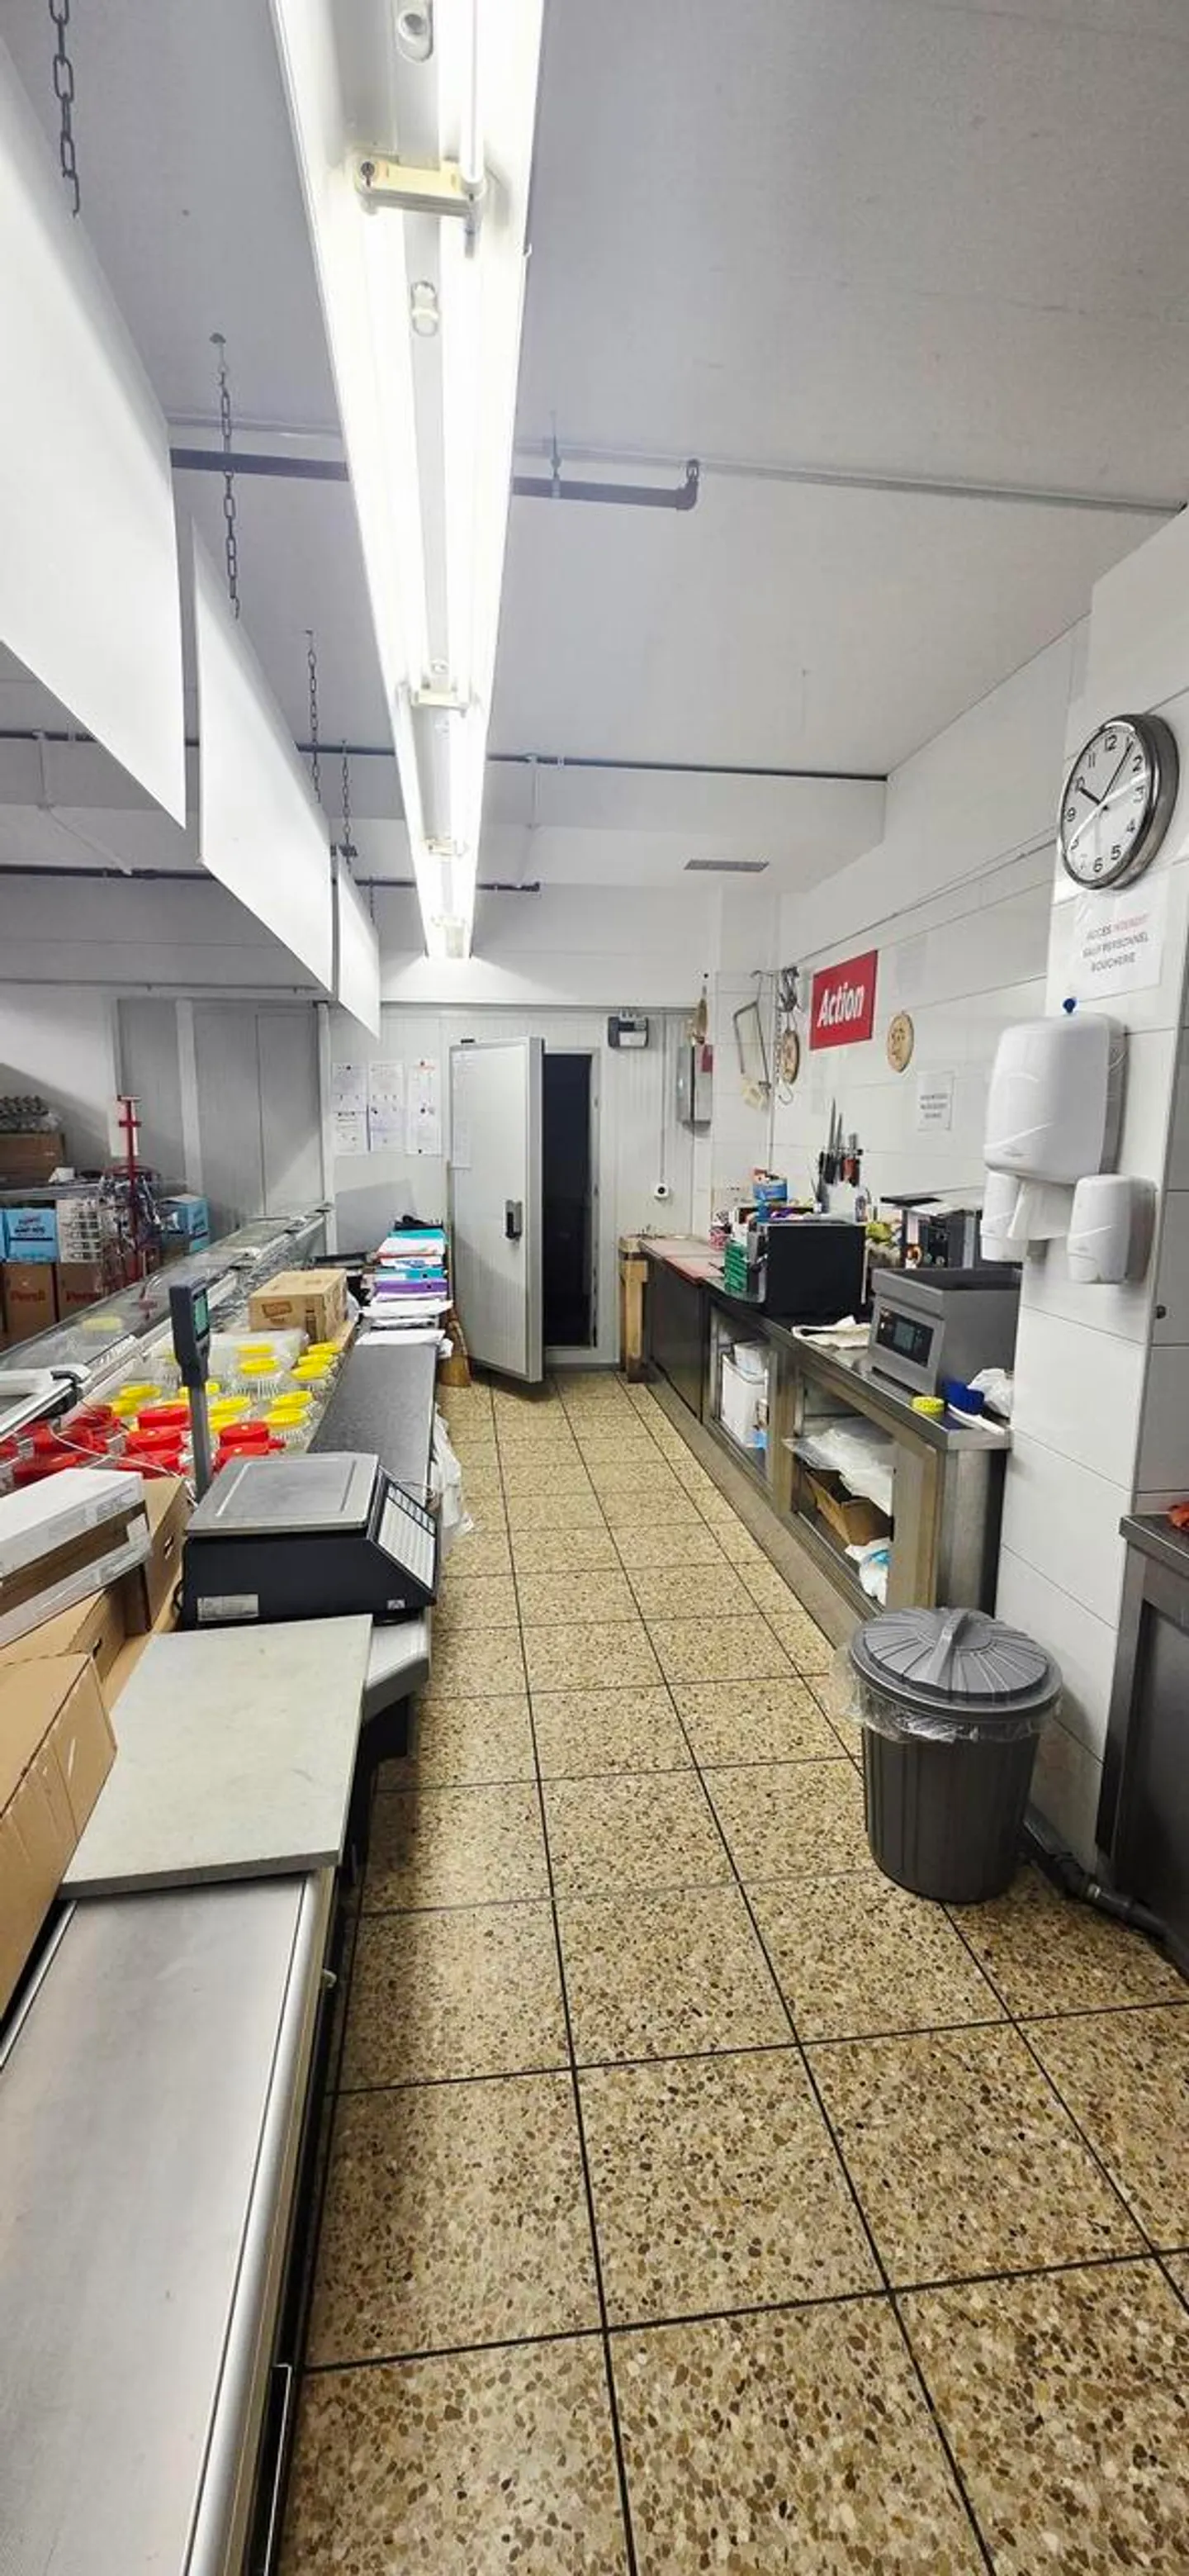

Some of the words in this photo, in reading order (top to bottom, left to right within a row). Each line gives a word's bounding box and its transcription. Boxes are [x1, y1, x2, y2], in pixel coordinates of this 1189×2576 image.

[1104, 734, 1117, 752] 12
[1087, 752, 1097, 768] 11
[1132, 755, 1144, 772] 2
[1133, 785, 1144, 803] 3
[1065, 807, 1078, 823] 9
[1125, 818, 1136, 834] 4
[1110, 845, 1121, 861] 5
[1093, 857, 1104, 873] 6
[817, 982, 865, 1027] Action
